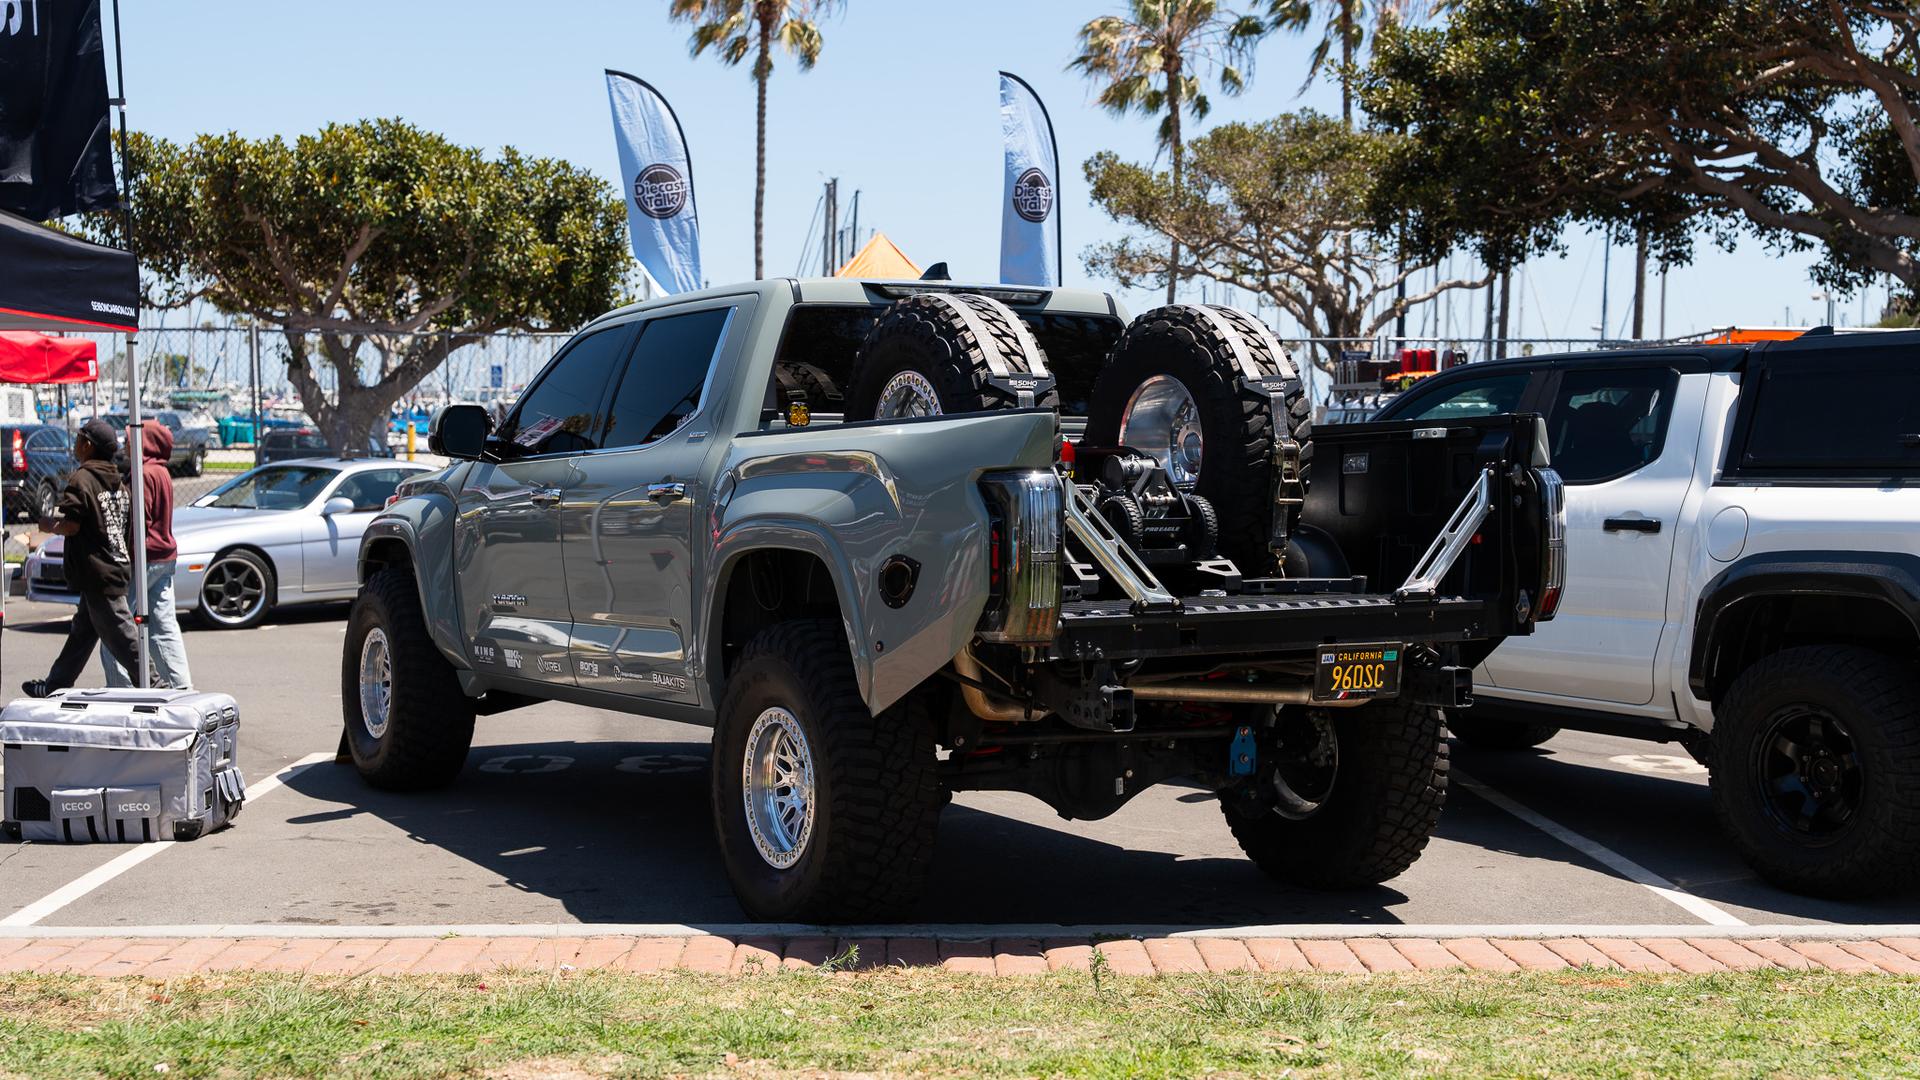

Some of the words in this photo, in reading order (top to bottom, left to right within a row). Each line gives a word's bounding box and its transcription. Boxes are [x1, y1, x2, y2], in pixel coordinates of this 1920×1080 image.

[634, 180, 686, 196] Diecast
[1014, 184, 1052, 197] Diecst
[647, 193, 677, 208] Talk
[474, 645, 495, 657] KING
[1338, 651, 1383, 661] CALIFORNIA
[1323, 654, 1335, 662] JAN
[61, 801, 93, 812] ICECO
[118, 803, 151, 812] ICECO
